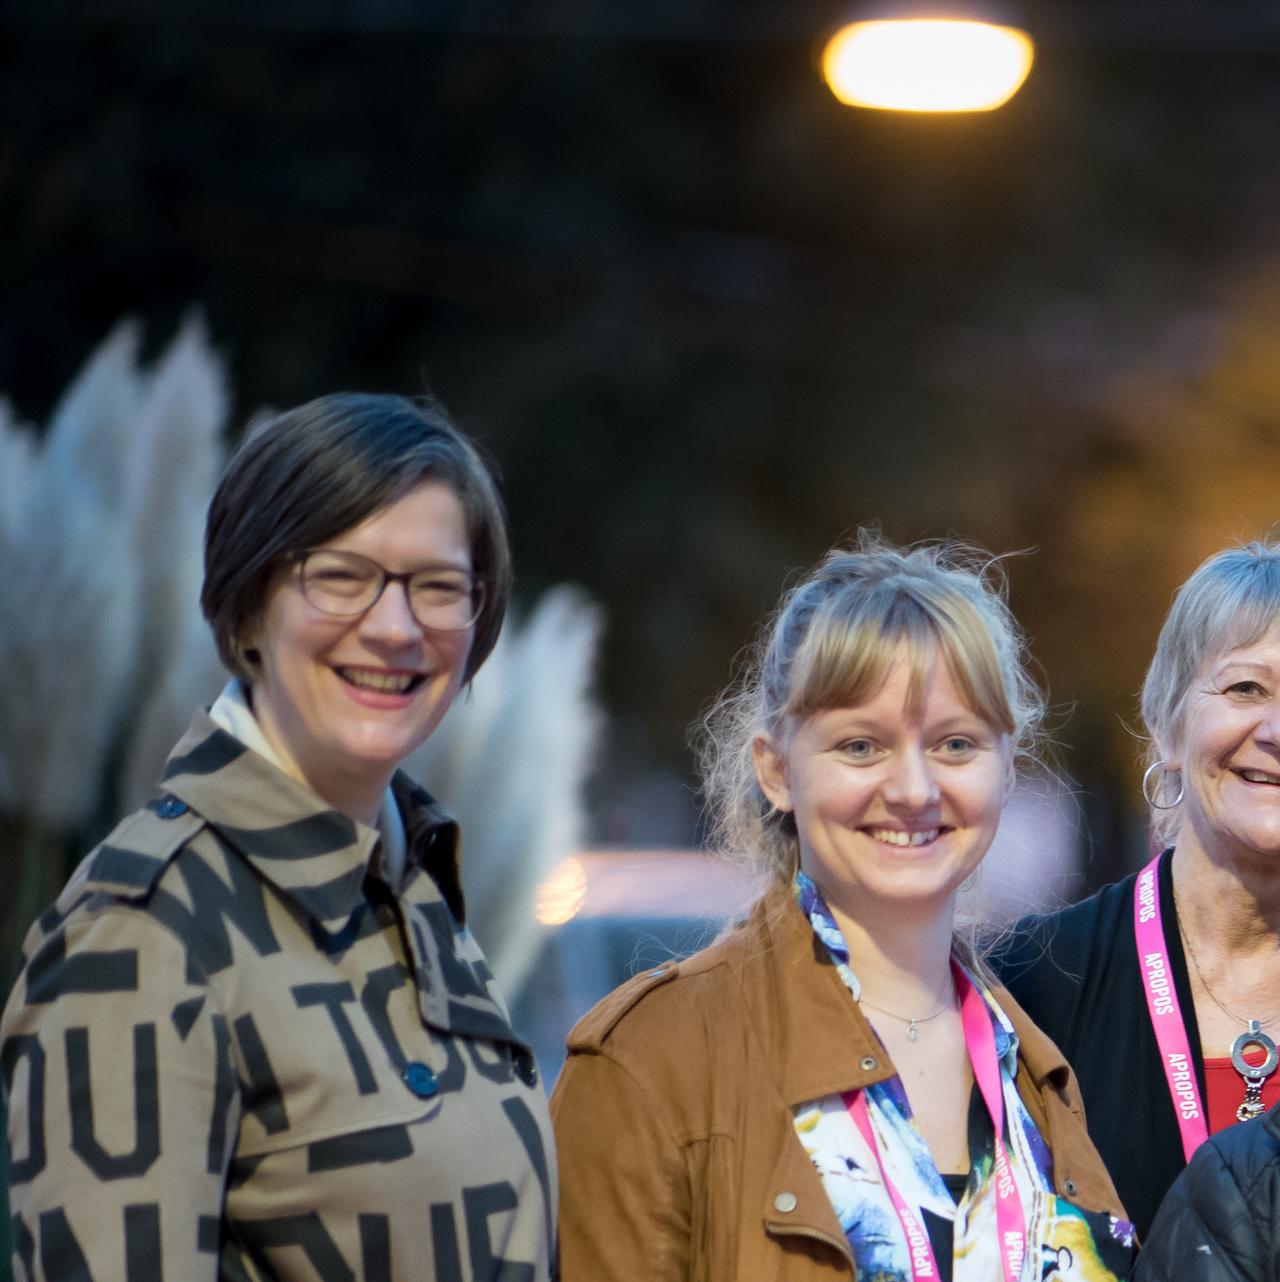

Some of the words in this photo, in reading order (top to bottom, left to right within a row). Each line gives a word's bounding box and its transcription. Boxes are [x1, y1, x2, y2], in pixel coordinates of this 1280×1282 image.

[1144, 952, 1174, 1016] APROPOS
[1168, 1053, 1199, 1121] APROPOS
[901, 1209, 933, 1277] APROPOS
